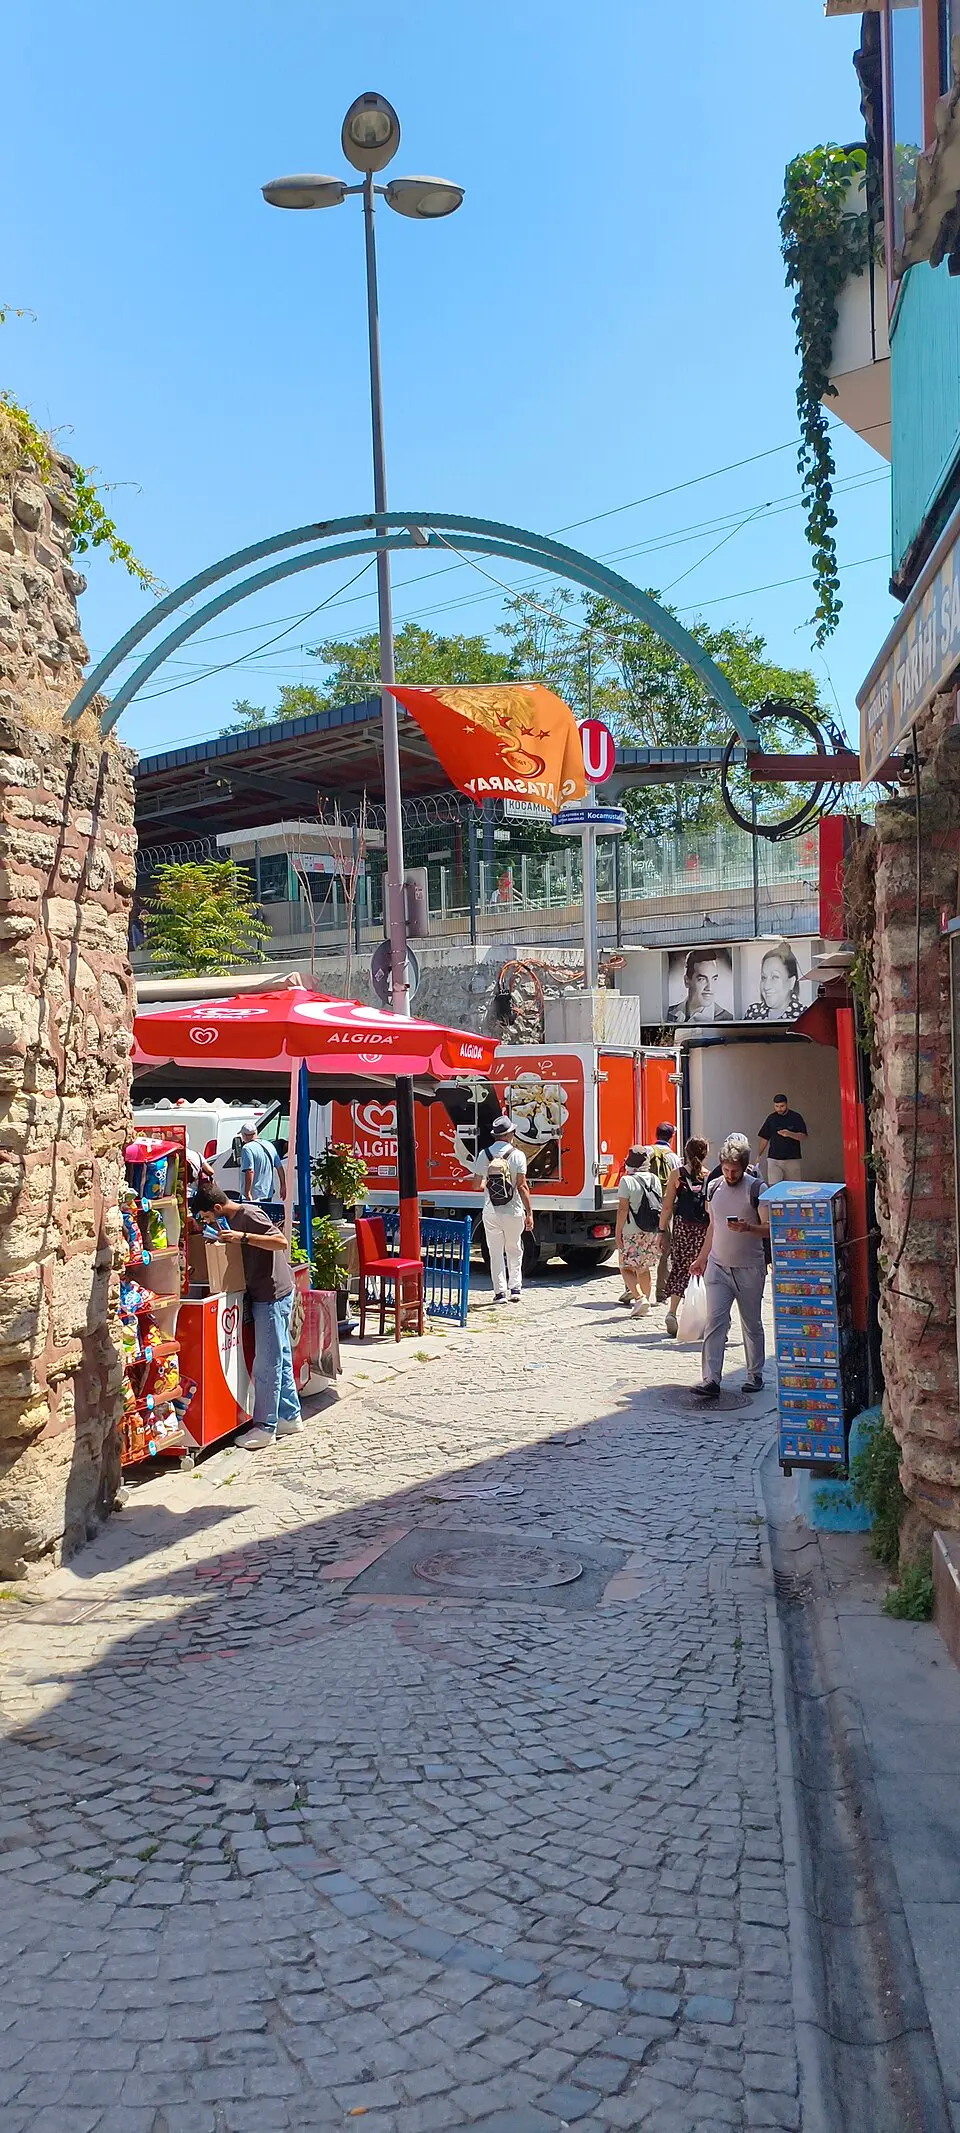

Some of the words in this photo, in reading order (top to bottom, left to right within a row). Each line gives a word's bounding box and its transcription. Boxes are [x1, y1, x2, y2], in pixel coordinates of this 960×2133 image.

[896, 595, 936, 717] TARİHİ
[582, 728, 607, 777] U
[327, 1032, 394, 1045] ALGIDA
[353, 1140, 398, 1157] ALGiD
